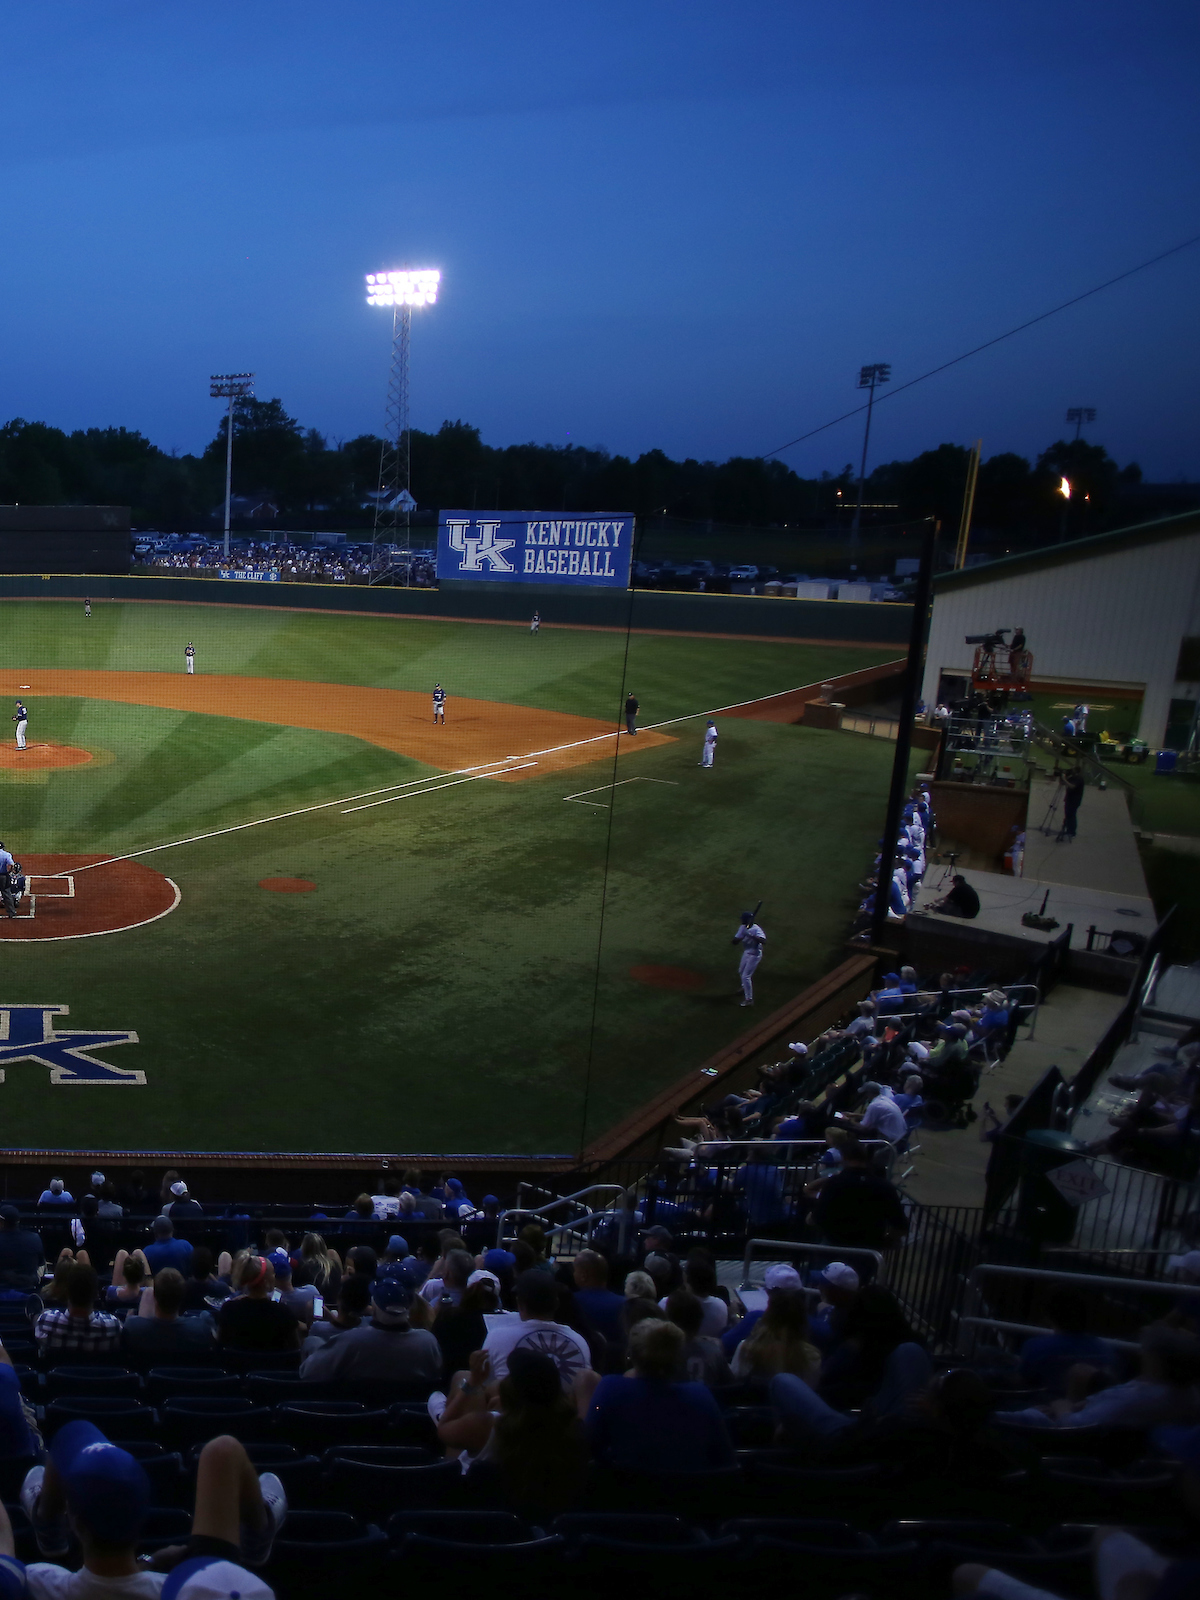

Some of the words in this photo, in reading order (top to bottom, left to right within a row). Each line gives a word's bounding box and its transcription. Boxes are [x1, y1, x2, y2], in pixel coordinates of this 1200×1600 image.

[446, 519, 516, 573] UK
[525, 520, 625, 547] KENTUCKY
[234, 571, 246, 579] THE
[247, 572, 264, 580] CLIFF
[523, 549, 615, 577] BASEBALL
[1056, 1169, 1097, 1190] EXIT
